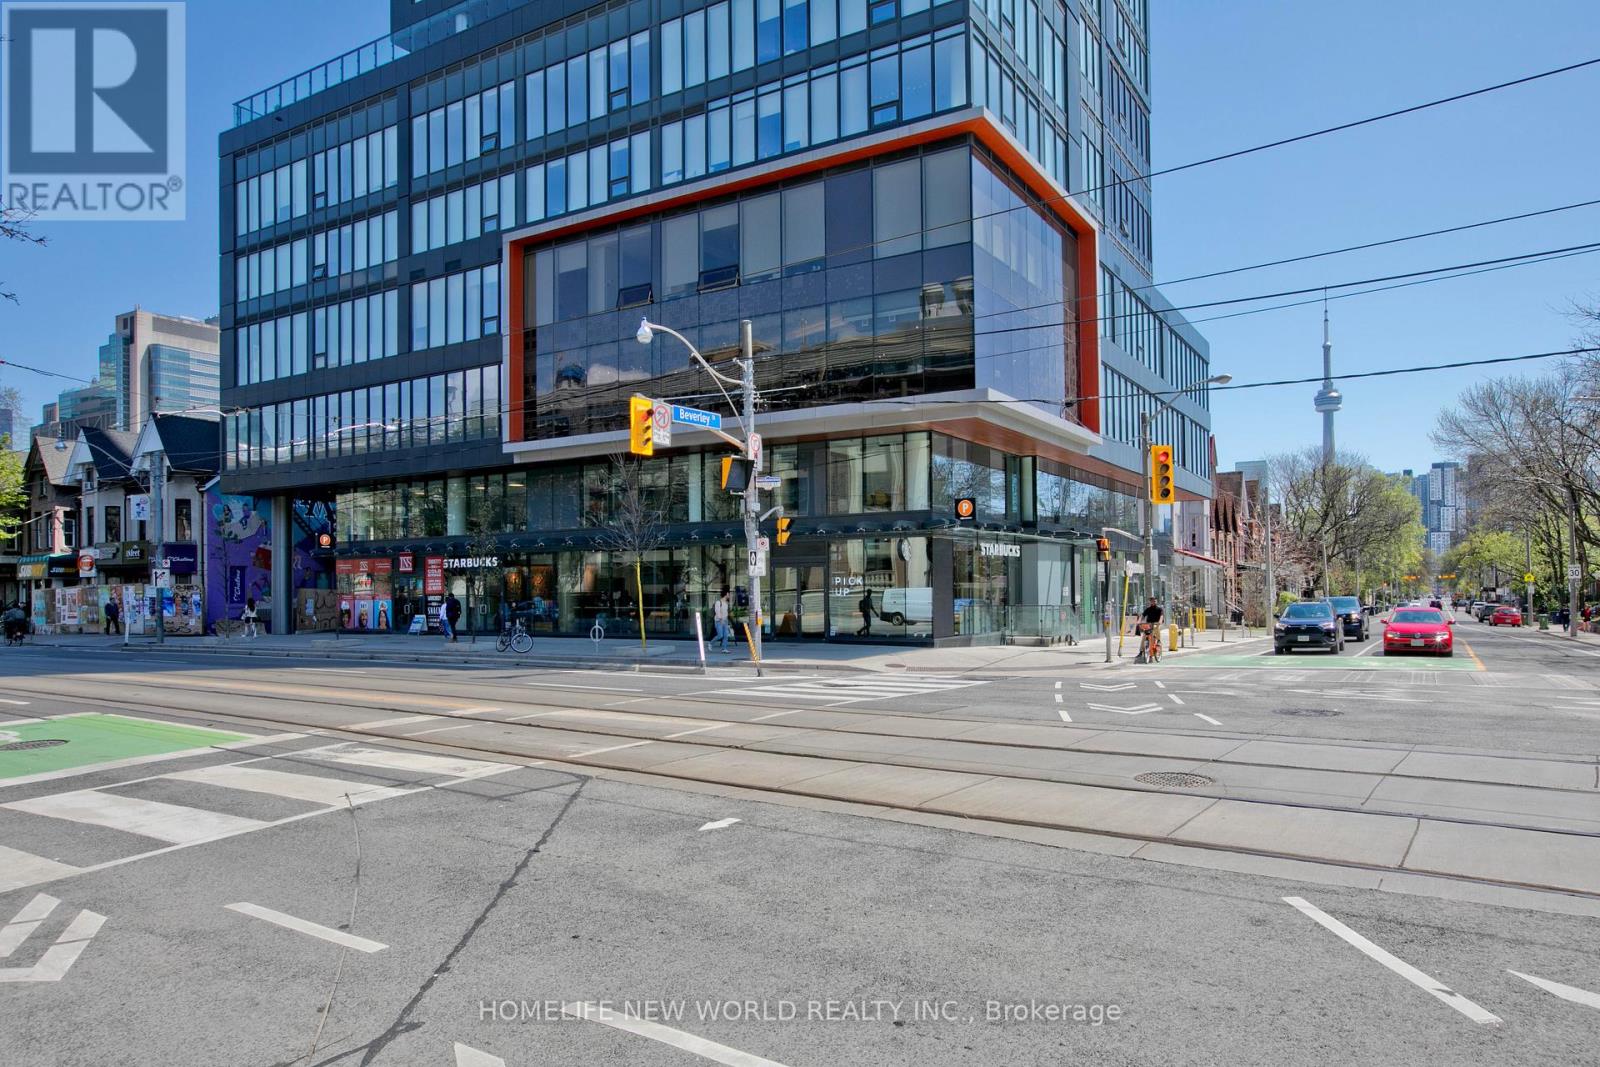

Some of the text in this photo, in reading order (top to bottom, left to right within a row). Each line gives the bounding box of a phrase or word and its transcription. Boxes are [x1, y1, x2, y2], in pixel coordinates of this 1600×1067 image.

[680, 403, 710, 426] Beverley
[980, 543, 1021, 557] STARBUCKS
[443, 556, 498, 568] STARBUCKS
[834, 577, 864, 586] PICK
[834, 588, 850, 597] UP
